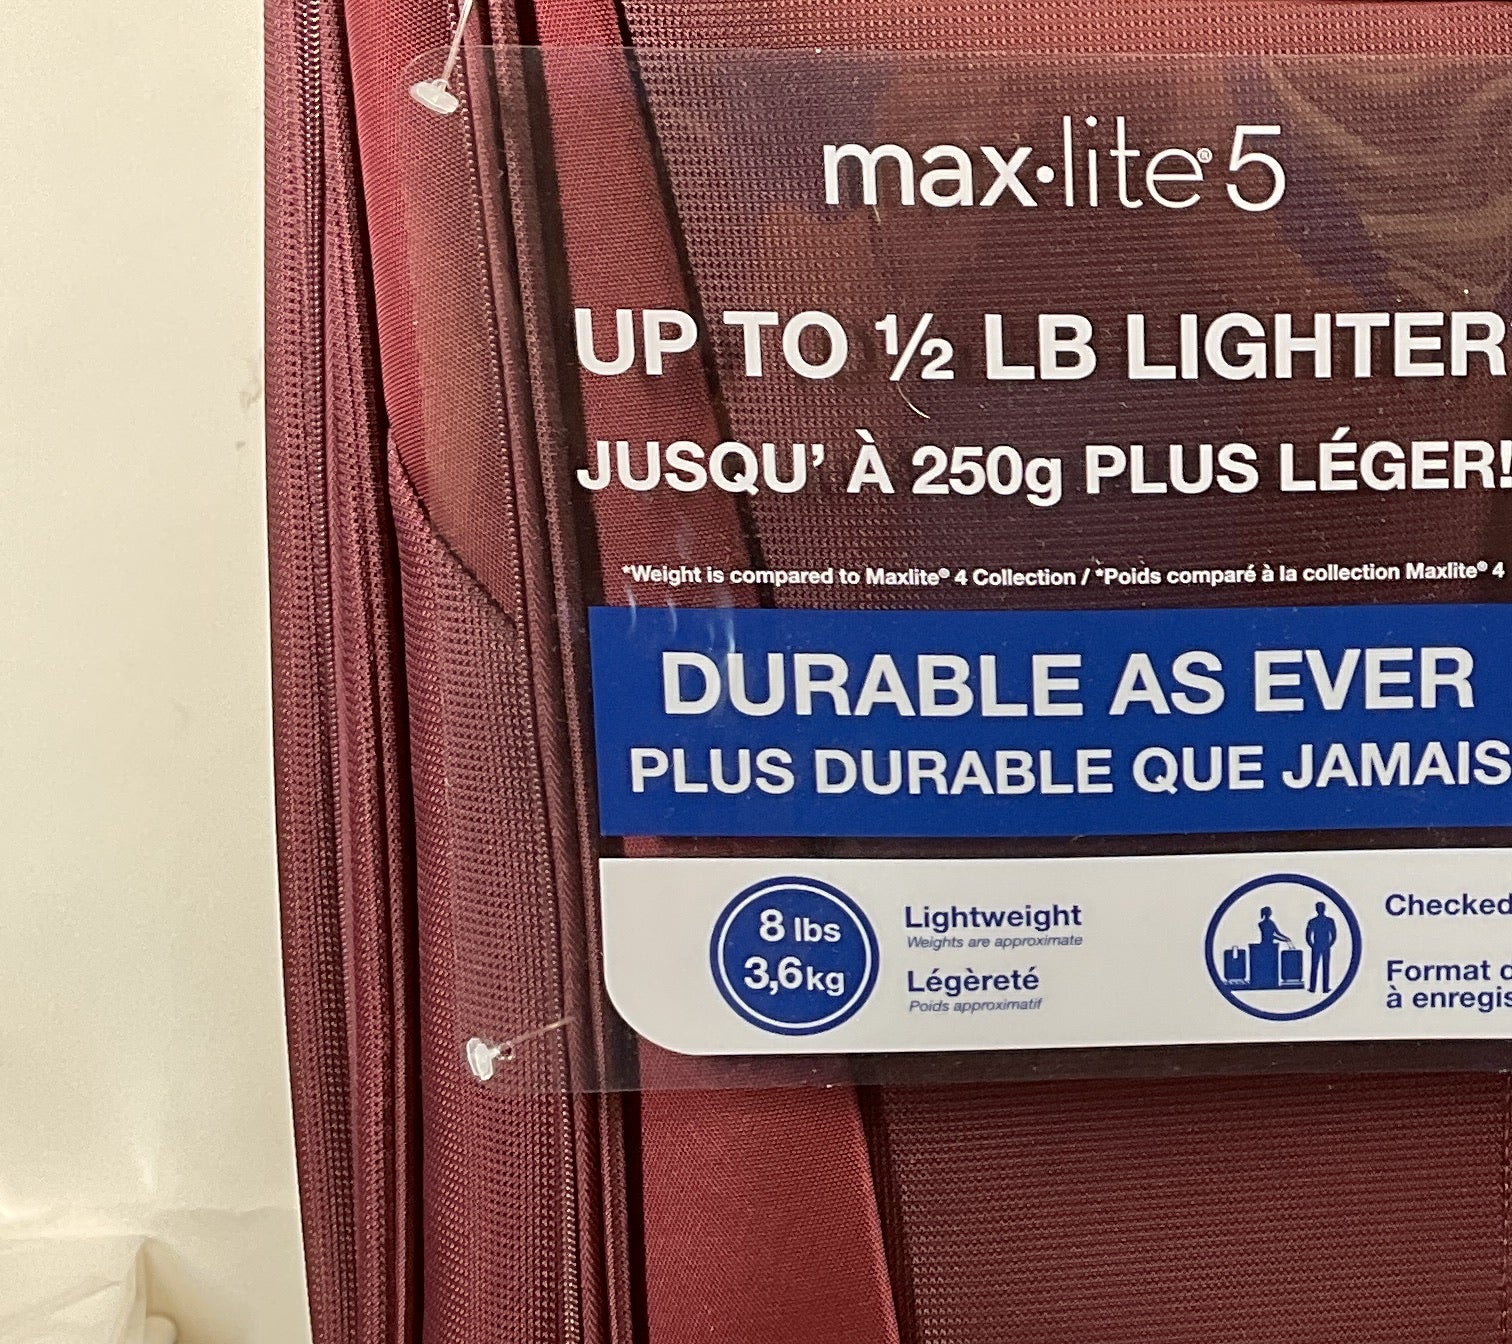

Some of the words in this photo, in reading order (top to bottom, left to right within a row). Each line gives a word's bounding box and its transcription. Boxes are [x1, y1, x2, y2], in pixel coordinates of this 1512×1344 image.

[1226, 124, 1286, 212] 5
[574, 307, 698, 376] UP
[722, 310, 848, 380] TO
[984, 313, 1097, 380] LB
[846, 428, 895, 494] À
[911, 445, 1062, 507] 250g
[1085, 442, 1259, 495] PLUS
[706, 566, 725, 584] is
[729, 567, 834, 588] compared
[838, 568, 861, 585] to
[954, 568, 969, 586] 4
[972, 568, 1077, 586] Collection
[1080, 567, 1091, 586] /
[1166, 563, 1257, 587] comparé
[1261, 563, 1275, 583] à
[1279, 564, 1298, 582] la
[1302, 563, 1401, 582] collection
[1491, 561, 1505, 579] 4
[662, 649, 1084, 717] DURABLE
[1108, 650, 1225, 716] AS
[1254, 646, 1475, 712] EVER
[630, 747, 795, 795] PLUS
[814, 748, 1114, 795] DURABLE
[1132, 745, 1264, 795] QUE
[1282, 739, 1512, 789] JAMAIS
[759, 908, 786, 942] 8
[794, 917, 841, 943] lbs
[905, 904, 1082, 934] Lightweight
[907, 936, 964, 952] Weights
[967, 938, 991, 948] are
[994, 934, 1083, 950] approximate
[744, 956, 803, 996] 3,6
[806, 968, 845, 997] kg
[907, 966, 1040, 998] Légèreté
[1387, 959, 1491, 982] Format
[908, 999, 950, 1012] Poids
[953, 997, 1043, 1015] approximatif
[1386, 984, 1402, 1009] à
